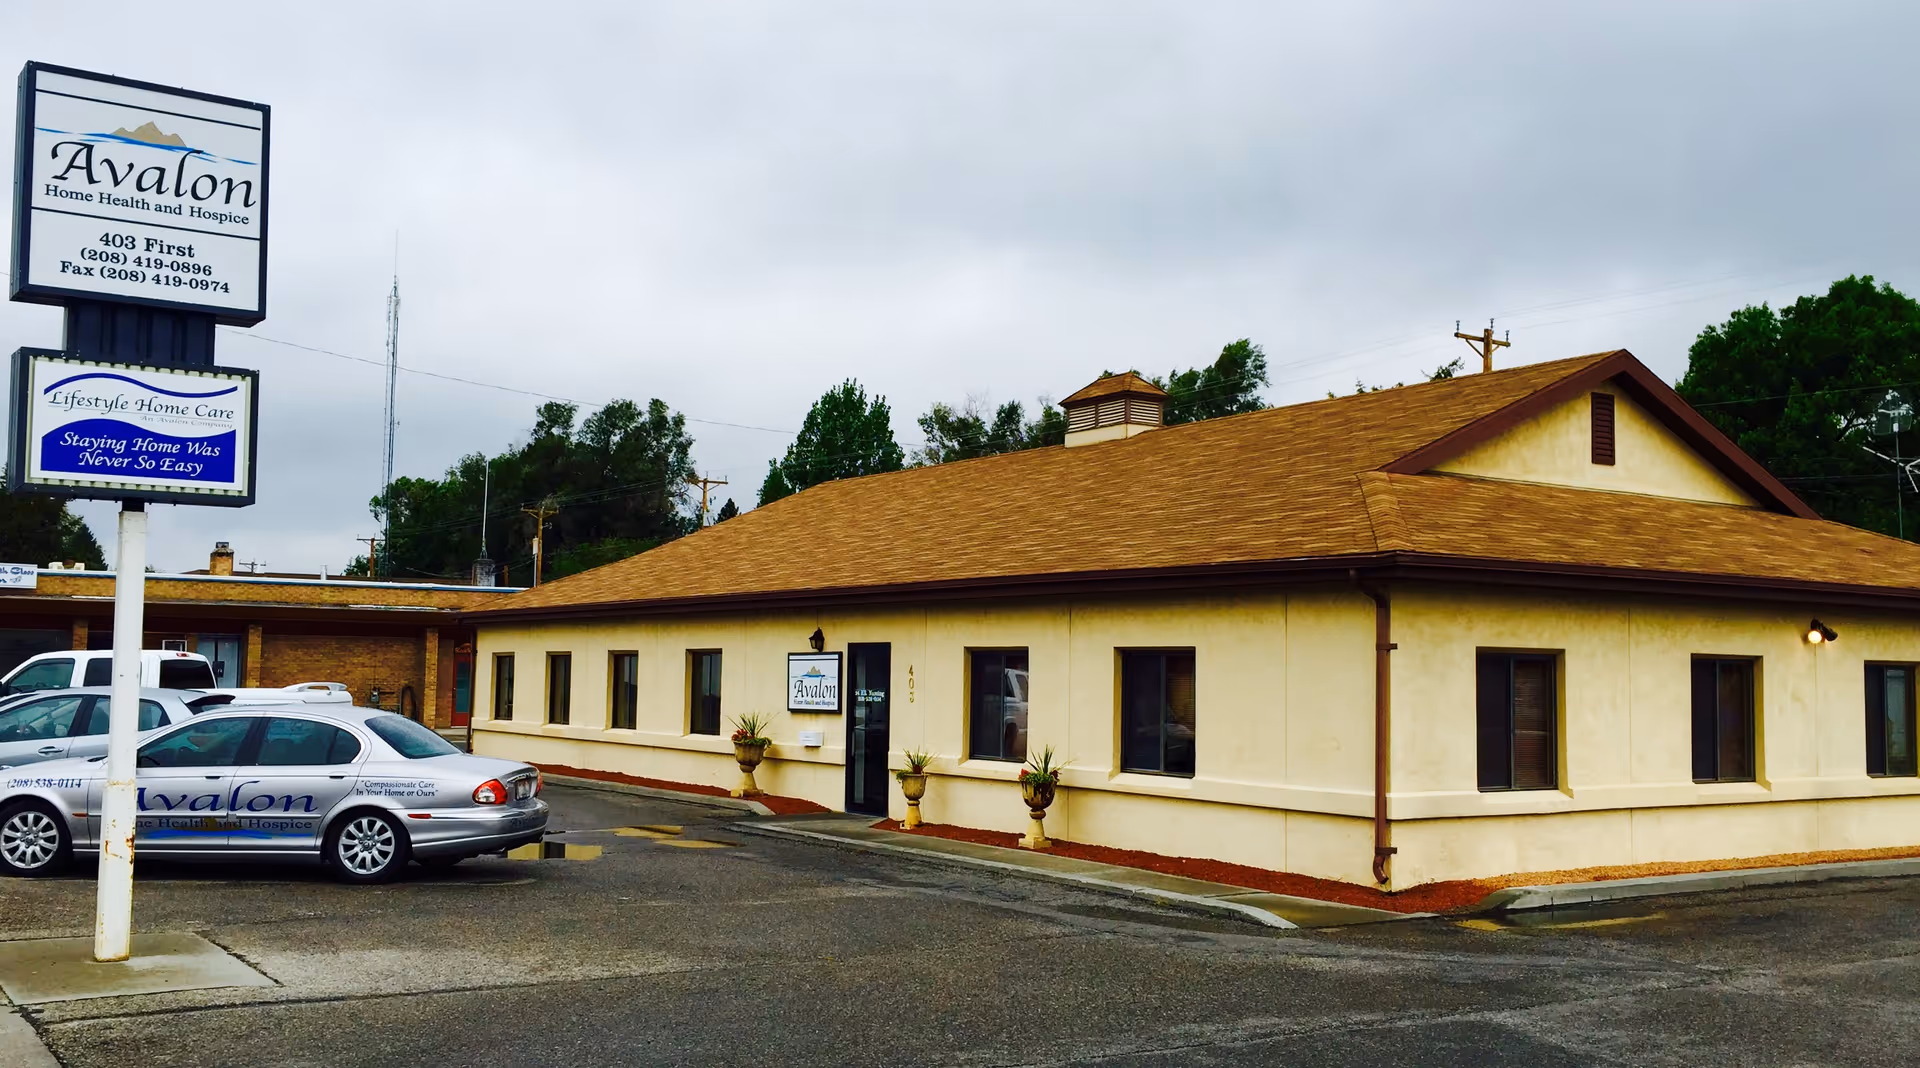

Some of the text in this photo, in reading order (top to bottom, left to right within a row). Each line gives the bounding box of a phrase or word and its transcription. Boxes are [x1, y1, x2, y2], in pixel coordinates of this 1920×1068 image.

[51, 141, 256, 208] Avalon
[44, 184, 250, 225] Home Health and Hospice
[99, 233, 195, 258] 403 First
[80, 247, 212, 276] (208) 419-0896
[60, 261, 230, 293] Fax (208) 419-0974
[48, 390, 234, 419] Lifestyle Home Care
[156, 417, 188, 425] Avalon
[190, 420, 233, 429] Company
[59, 431, 220, 457] Staying Home Was
[78, 452, 203, 477] Never So Easy
[794, 677, 836, 699] Avalon
[356, 788, 364, 796] In
[418, 781, 435, 789] Care
[158, 817, 209, 828] Health
[213, 818, 243, 829] and
[248, 818, 312, 831] Hospice
